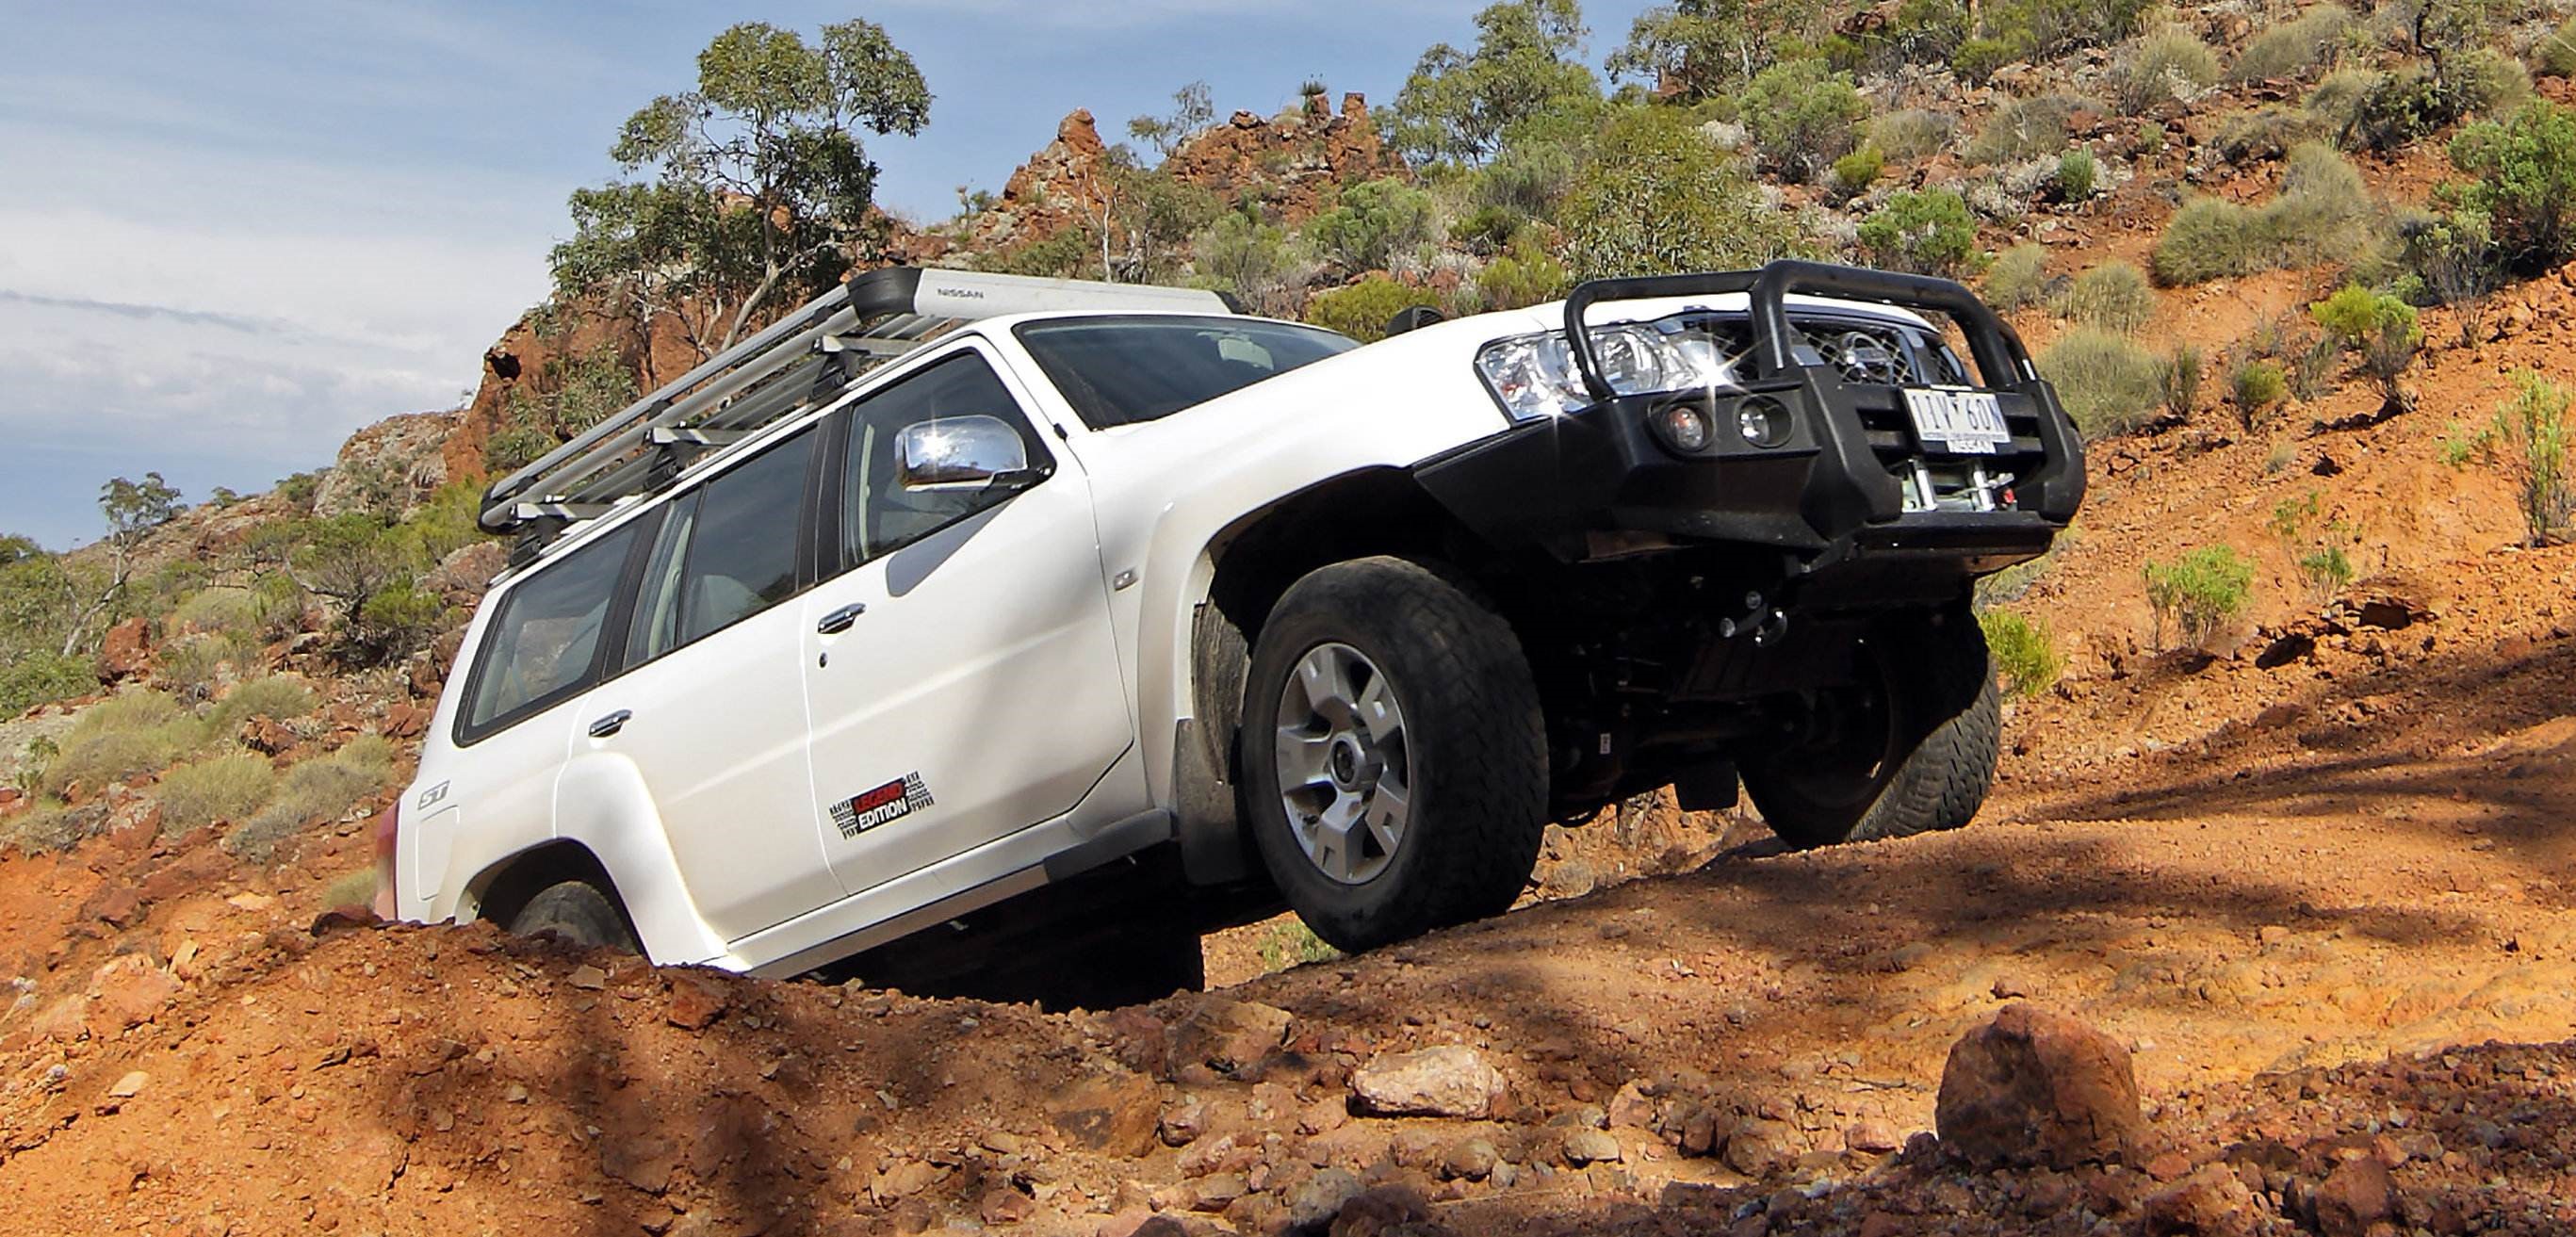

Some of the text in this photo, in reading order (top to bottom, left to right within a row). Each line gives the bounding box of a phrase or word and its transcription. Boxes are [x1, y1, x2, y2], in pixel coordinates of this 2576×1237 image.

[937, 287, 985, 300] NISSAN
[417, 780, 450, 810] ST
[854, 783, 904, 812] LEGEND
[858, 797, 908, 830] EDITION
